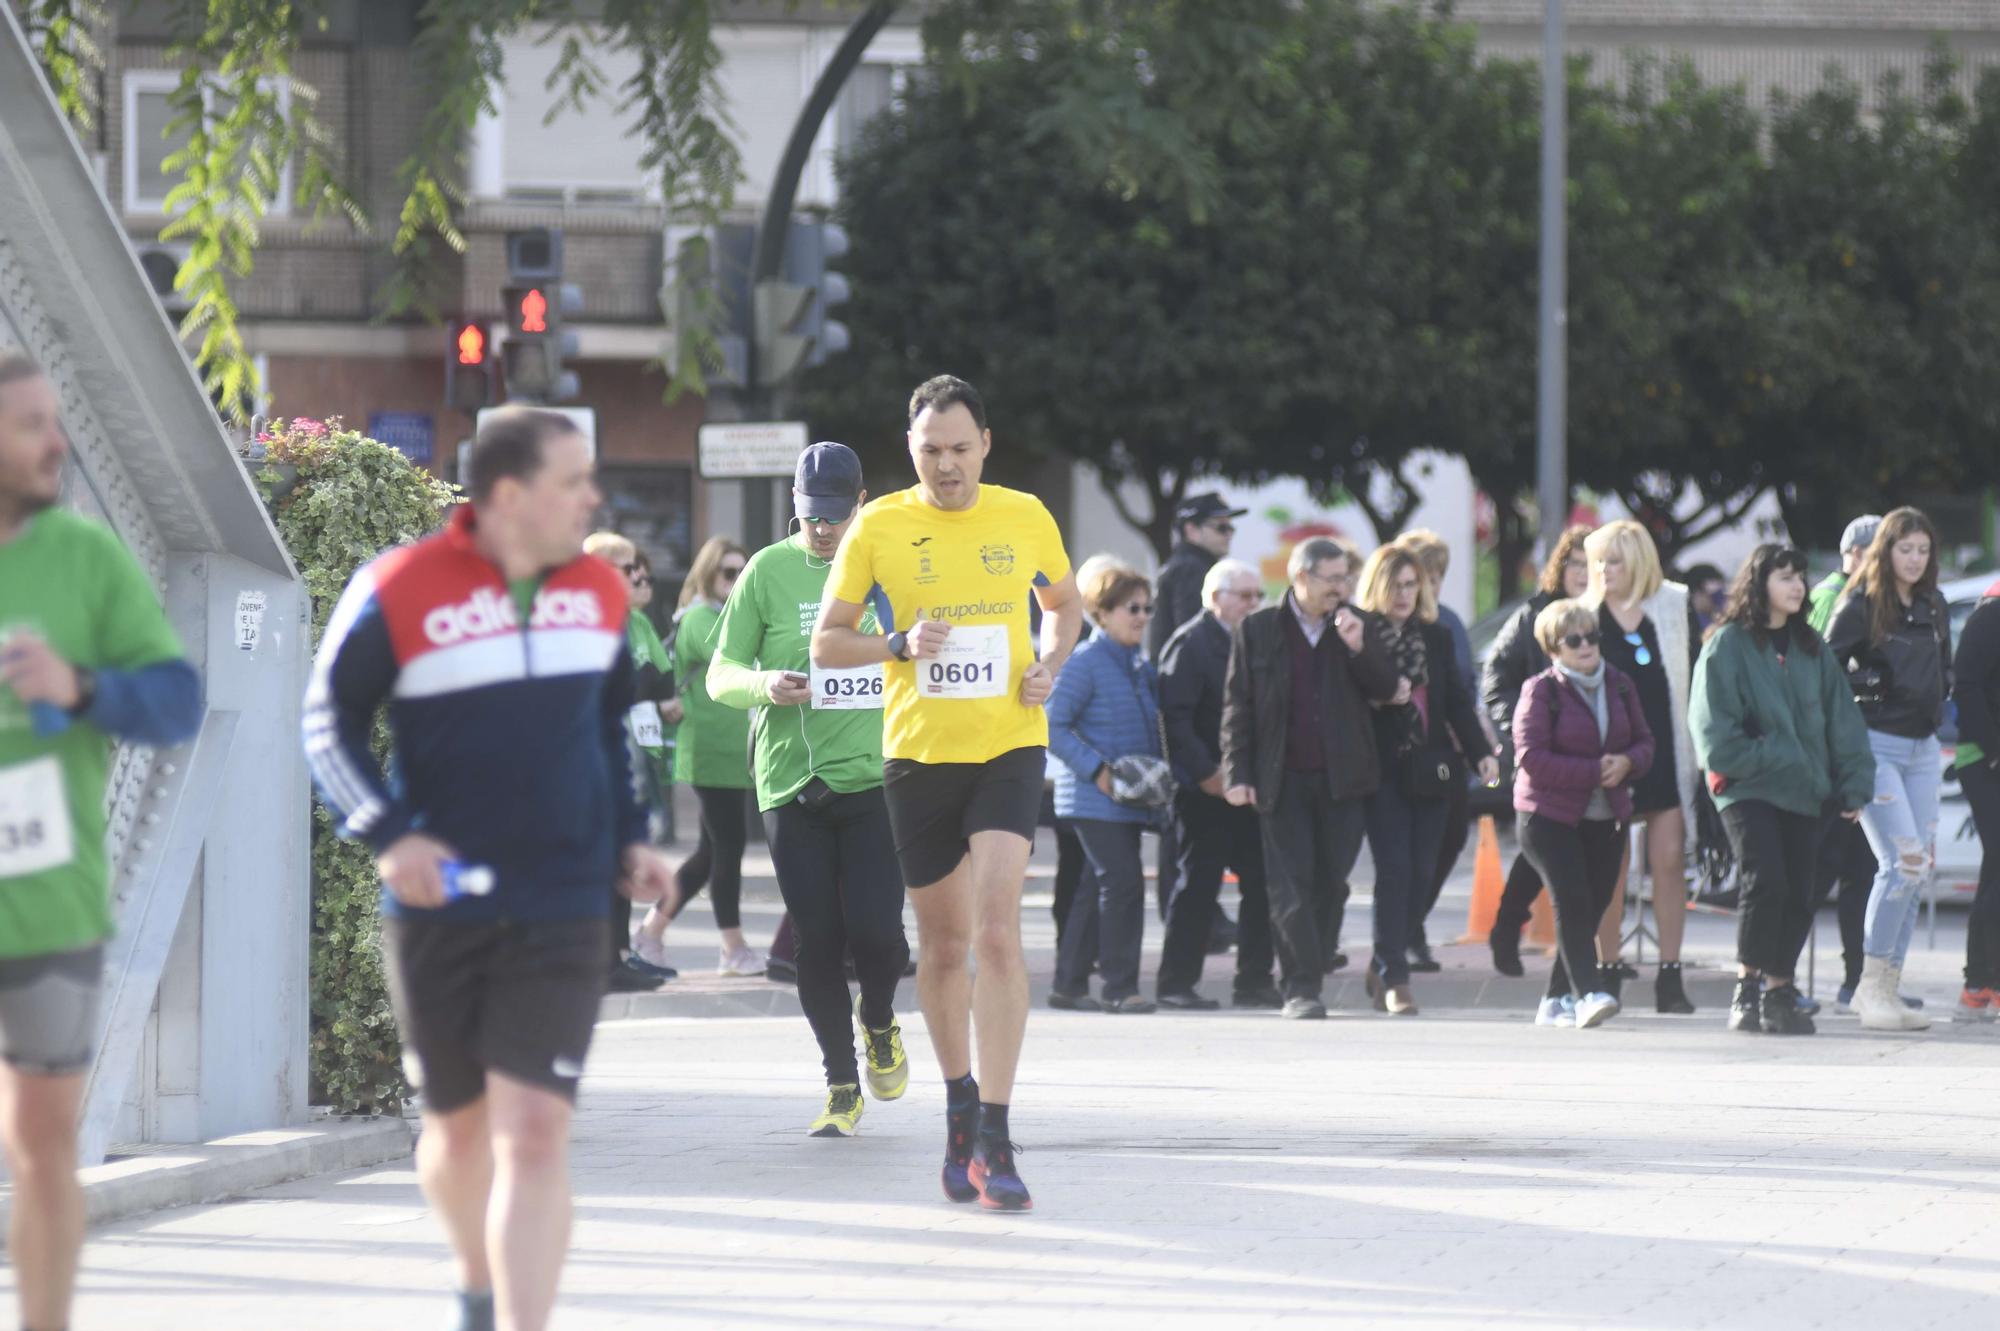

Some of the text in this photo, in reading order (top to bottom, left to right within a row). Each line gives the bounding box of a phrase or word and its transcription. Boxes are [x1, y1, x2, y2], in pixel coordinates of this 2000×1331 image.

[931, 600, 1013, 621] grupolucas
[800, 628, 810, 636] el
[929, 662, 993, 684] 0601
[824, 677, 883, 696] 0326
